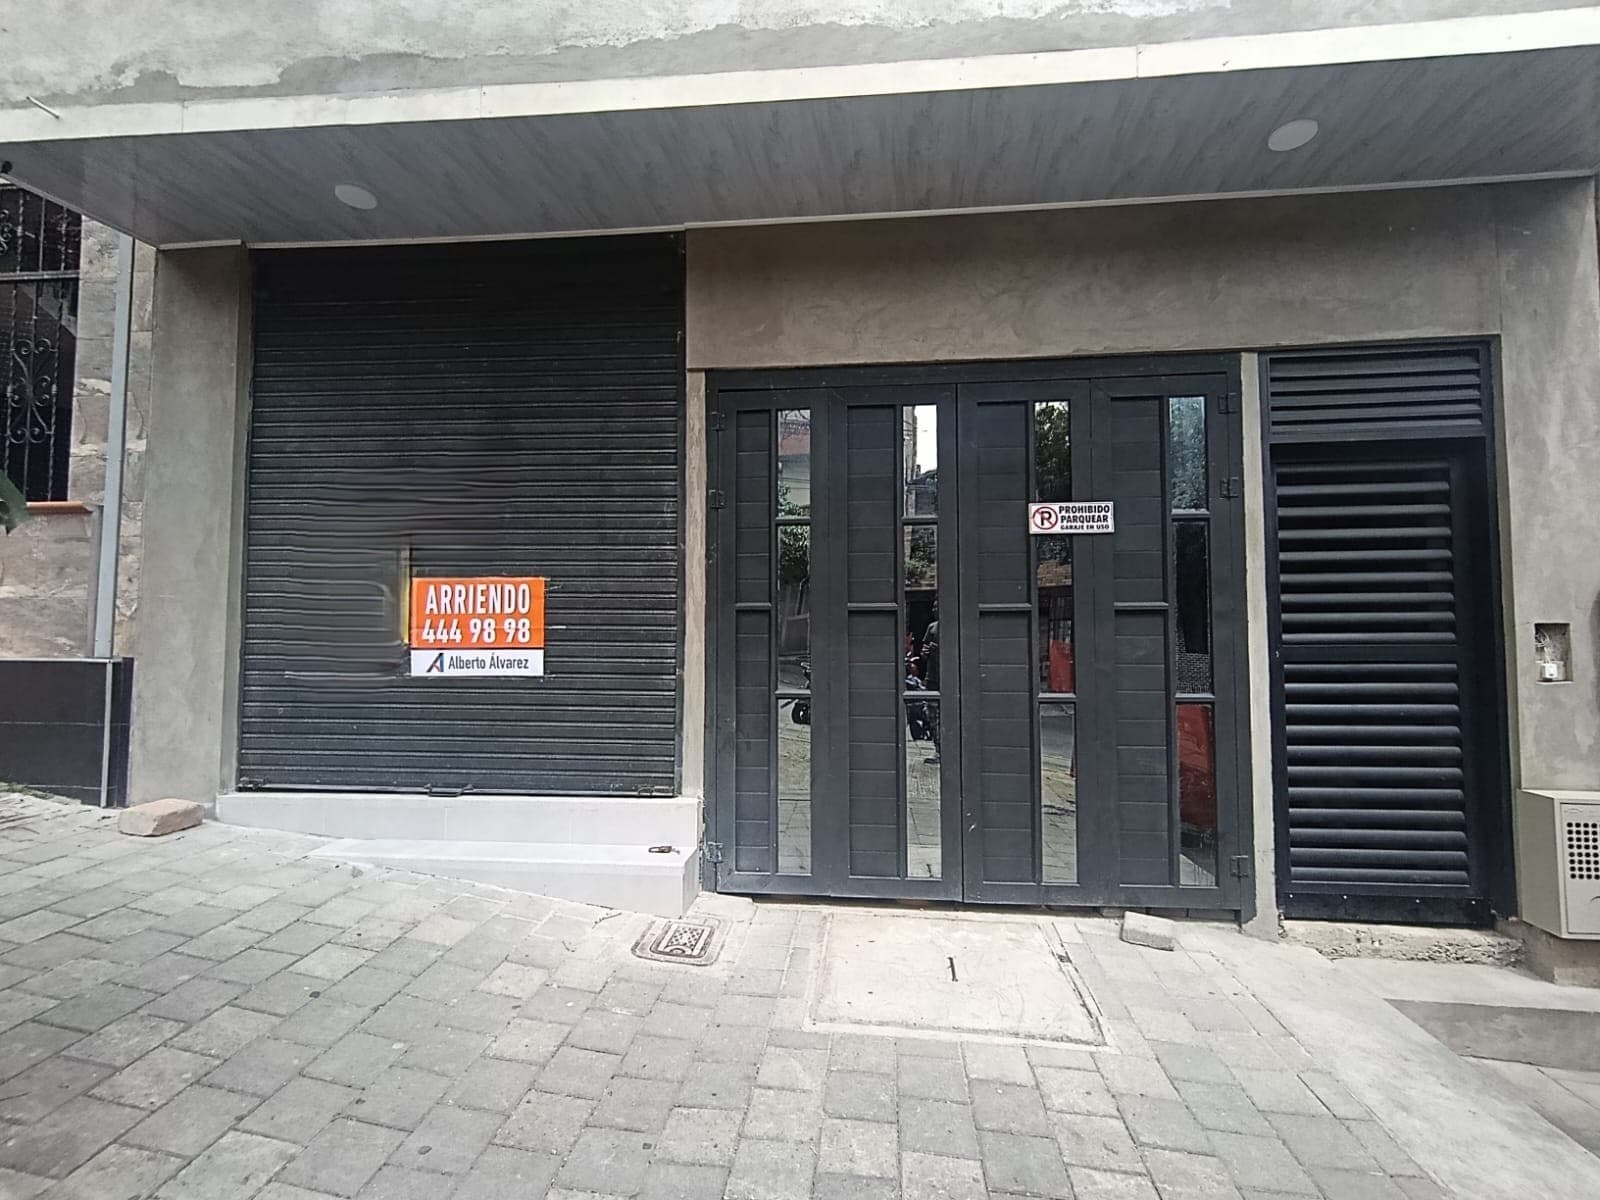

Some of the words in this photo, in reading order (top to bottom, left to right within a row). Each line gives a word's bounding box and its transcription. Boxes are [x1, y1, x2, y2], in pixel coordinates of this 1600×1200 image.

[1058, 505, 1110, 514] PROHIBIDO
[1060, 514, 1109, 524] PARQUEAR
[425, 583, 531, 615] ARRIENDO
[421, 618, 462, 643] 444
[469, 618, 496, 643] 98
[503, 618, 531, 643] 98
[448, 655, 486, 669] Alberto
[489, 652, 529, 669] Álvarez
